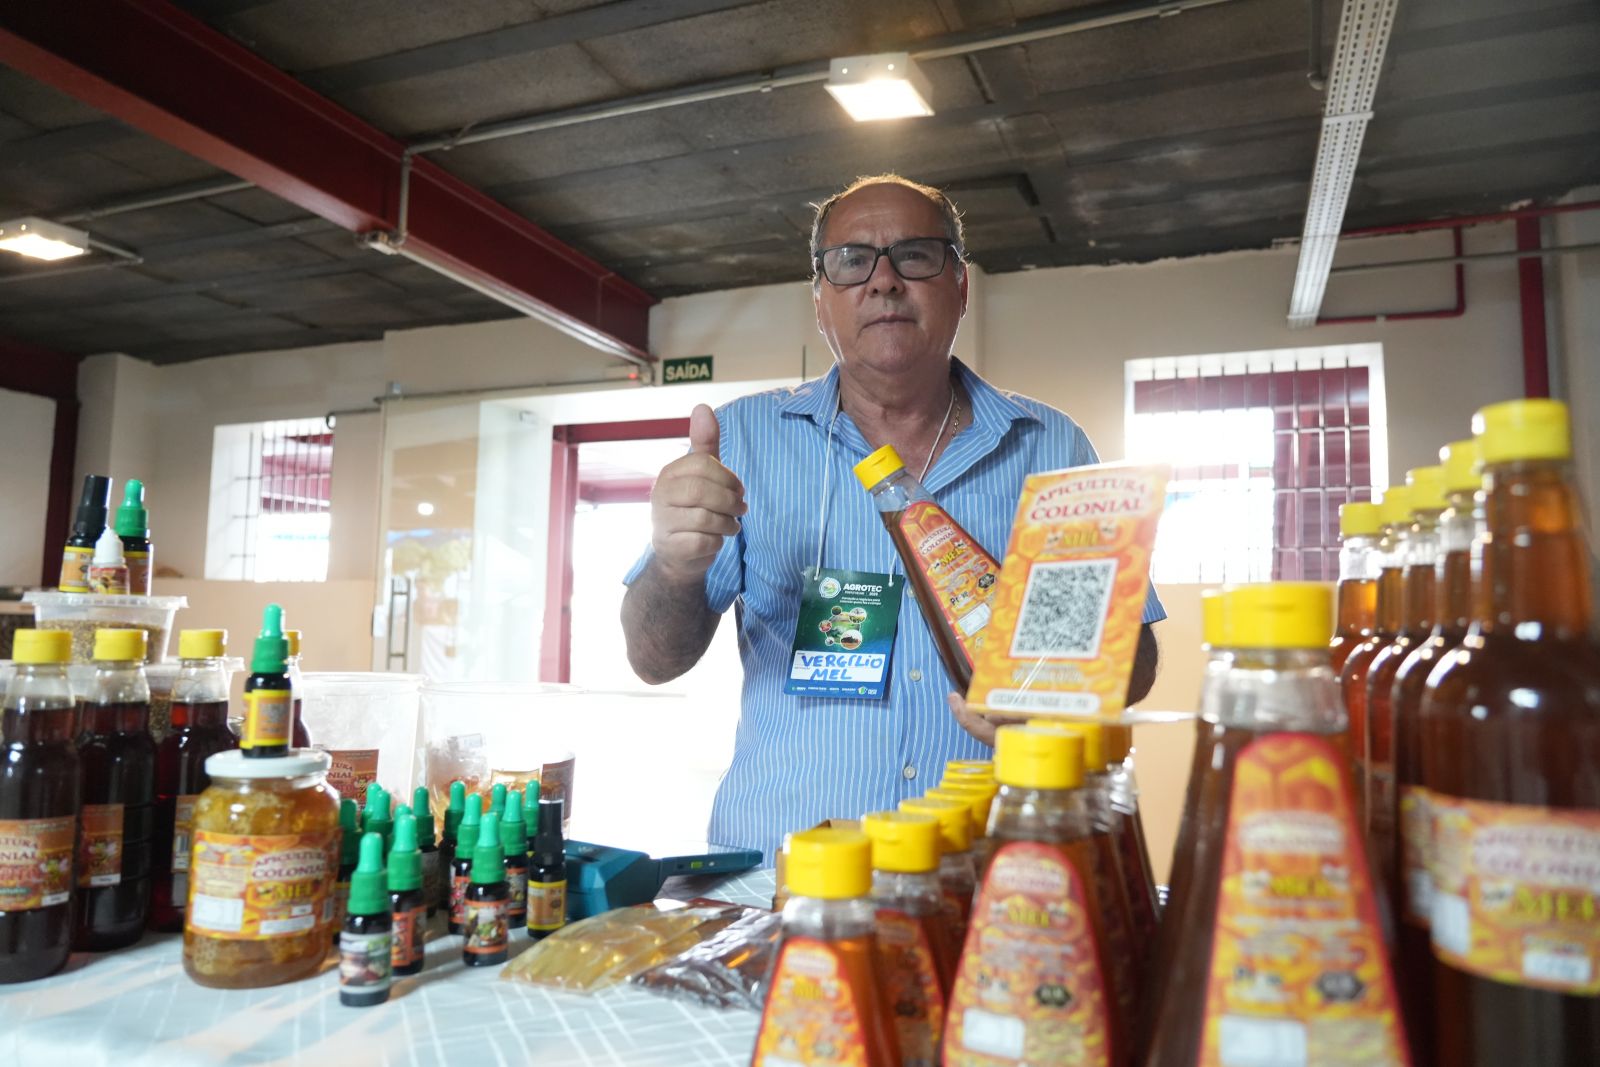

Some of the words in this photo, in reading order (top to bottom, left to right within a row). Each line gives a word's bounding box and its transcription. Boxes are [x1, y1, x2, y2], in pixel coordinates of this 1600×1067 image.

[665, 361, 710, 381] SAÍDA
[1036, 477, 1146, 504] APICULTURA
[1031, 499, 1143, 521] COLONIAL
[919, 526, 952, 550] APICULTURA
[922, 531, 956, 556] COLONIAL
[940, 547, 966, 567] MEL
[843, 583, 883, 593] AGROTEC
[809, 667, 853, 681] MEL
